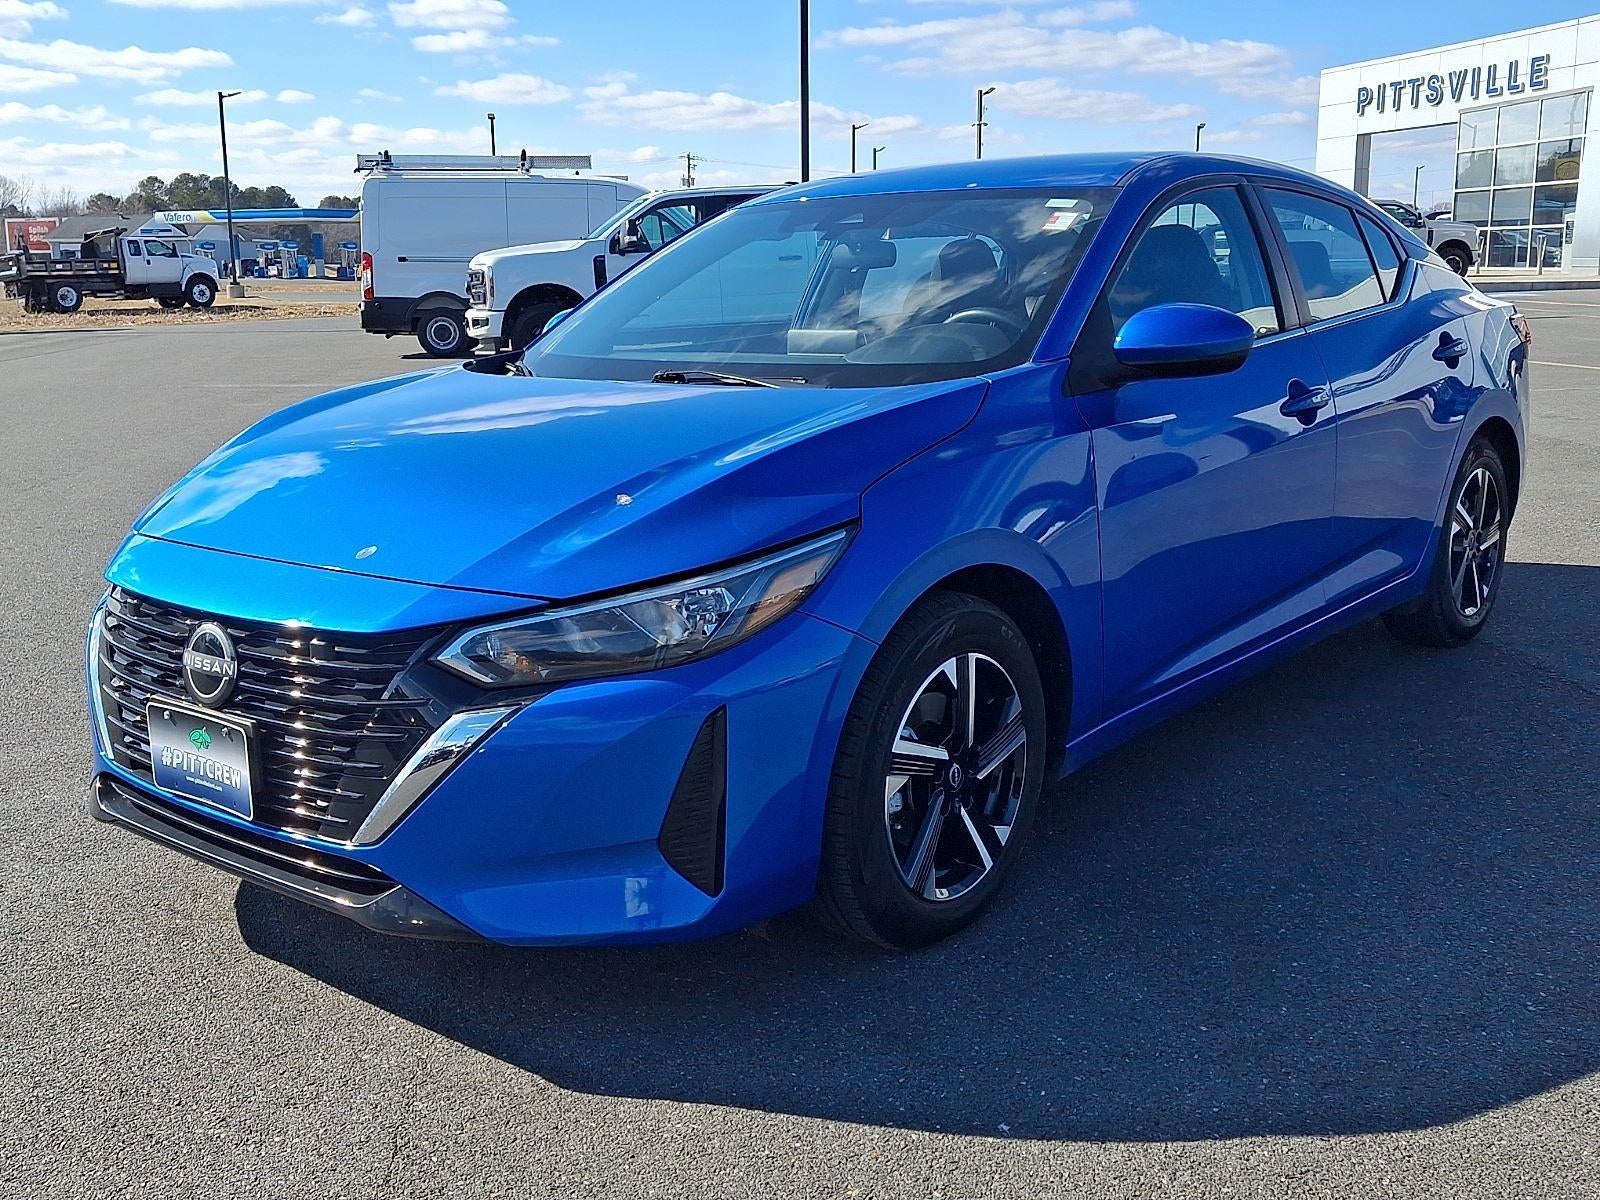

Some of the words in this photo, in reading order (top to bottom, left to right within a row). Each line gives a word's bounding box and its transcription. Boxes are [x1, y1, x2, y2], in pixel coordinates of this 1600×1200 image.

[1356, 53, 1551, 117] PITTSVILLE
[163, 212, 192, 222] Valero
[184, 652, 234, 676] NISSAN
[161, 745, 242, 790] #PITTCREW
